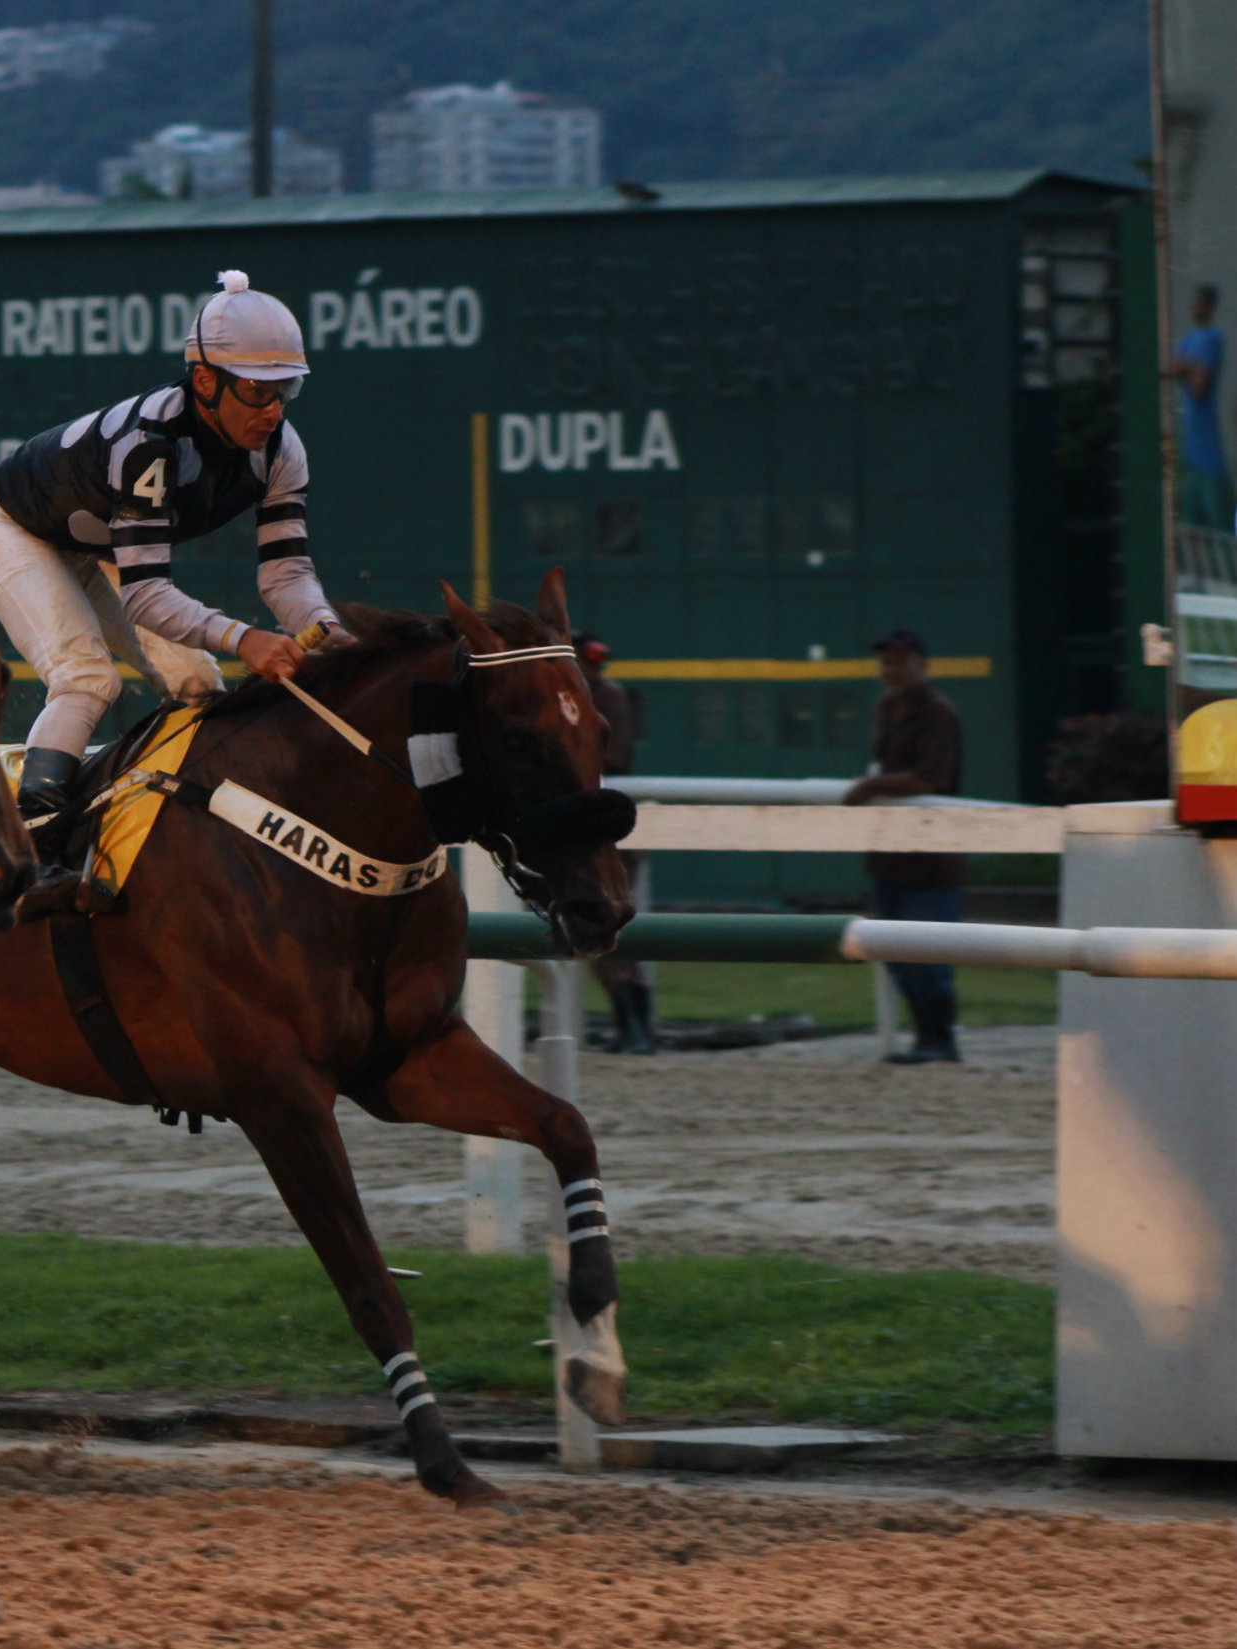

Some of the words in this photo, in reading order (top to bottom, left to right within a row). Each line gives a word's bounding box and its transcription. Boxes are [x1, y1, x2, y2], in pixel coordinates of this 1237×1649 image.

[1, 294, 152, 358] RATEIO
[309, 267, 483, 351] PÁREO
[499, 410, 681, 474] DUPLA
[133, 457, 167, 508] 4
[256, 812, 379, 887] HARAS
